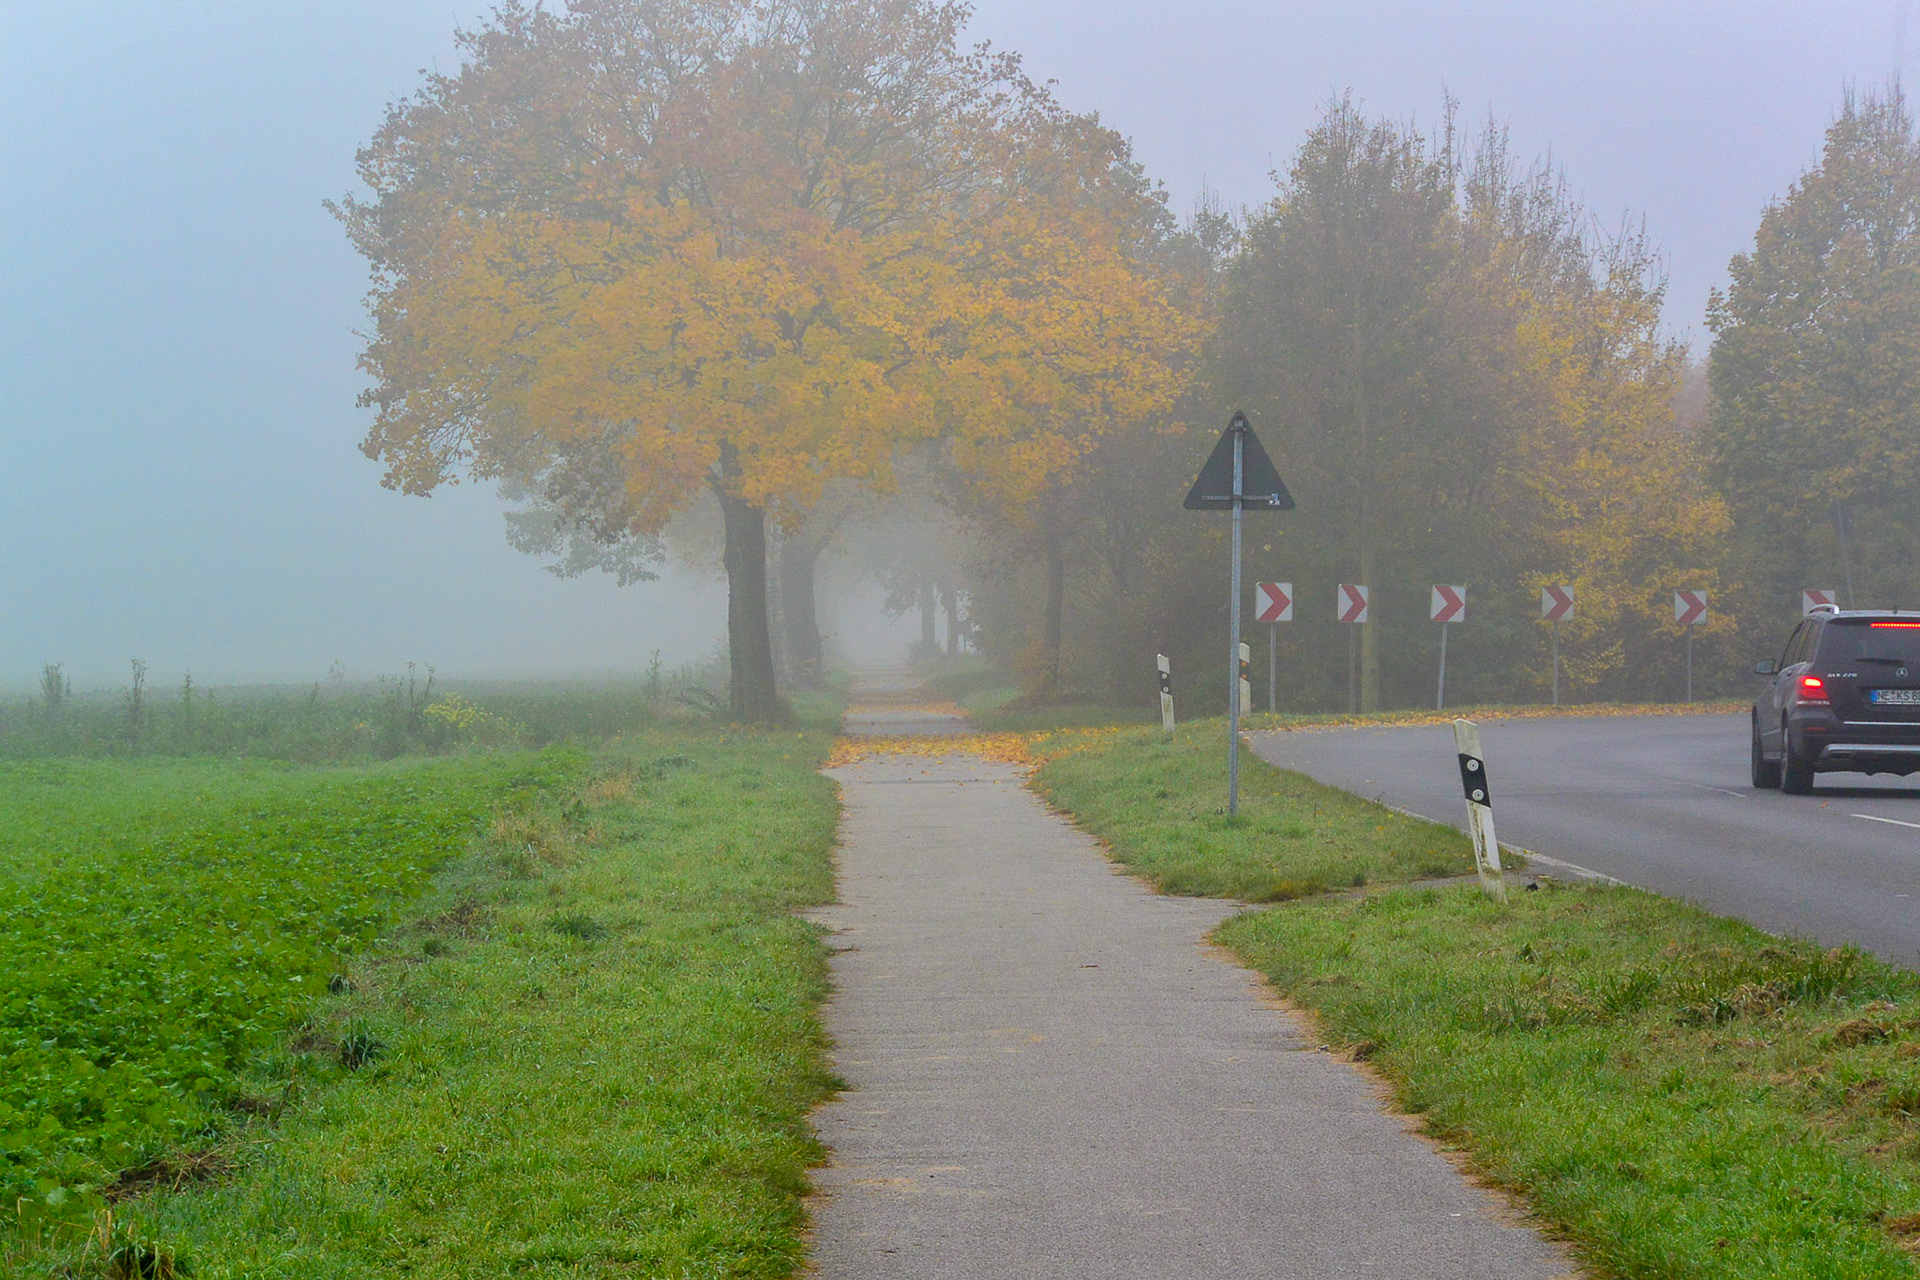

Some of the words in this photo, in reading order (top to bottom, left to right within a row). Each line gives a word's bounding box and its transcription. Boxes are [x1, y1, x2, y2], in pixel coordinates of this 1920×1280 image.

[1877, 690, 1890, 701] NE
[1896, 690, 1910, 701] KS
[1911, 690, 1920, 701] 8
